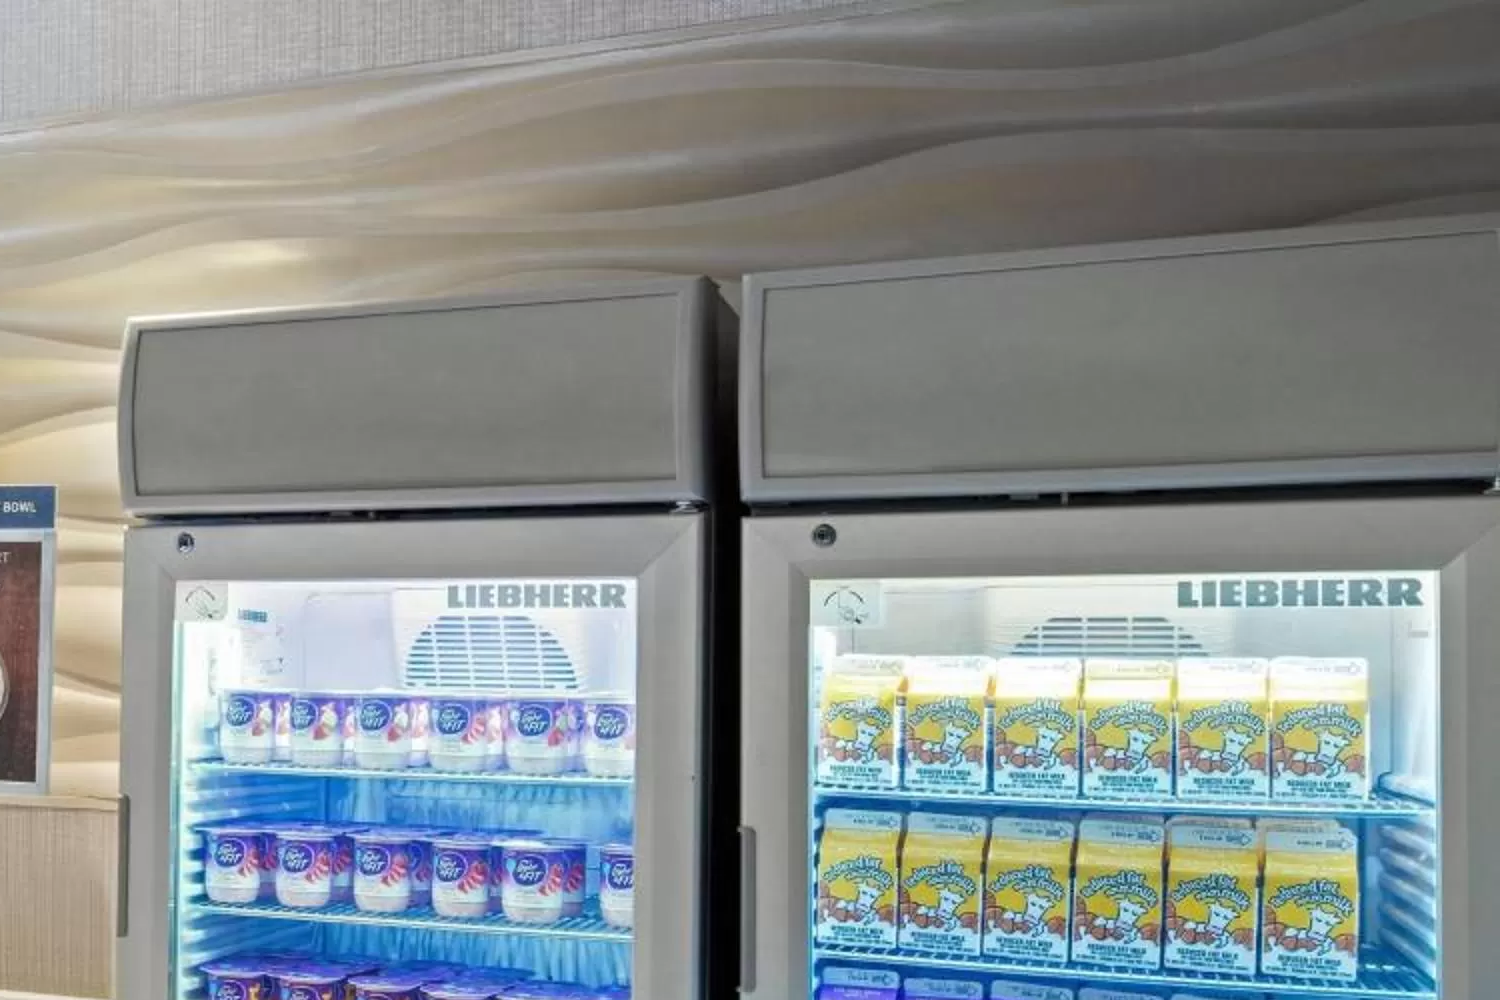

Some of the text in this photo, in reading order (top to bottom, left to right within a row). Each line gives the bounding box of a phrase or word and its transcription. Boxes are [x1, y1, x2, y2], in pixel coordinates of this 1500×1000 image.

[3, 502, 37, 513] BOWL
[447, 584, 627, 609] LIEBHERR
[1177, 579, 1425, 609] LIEBHERR
